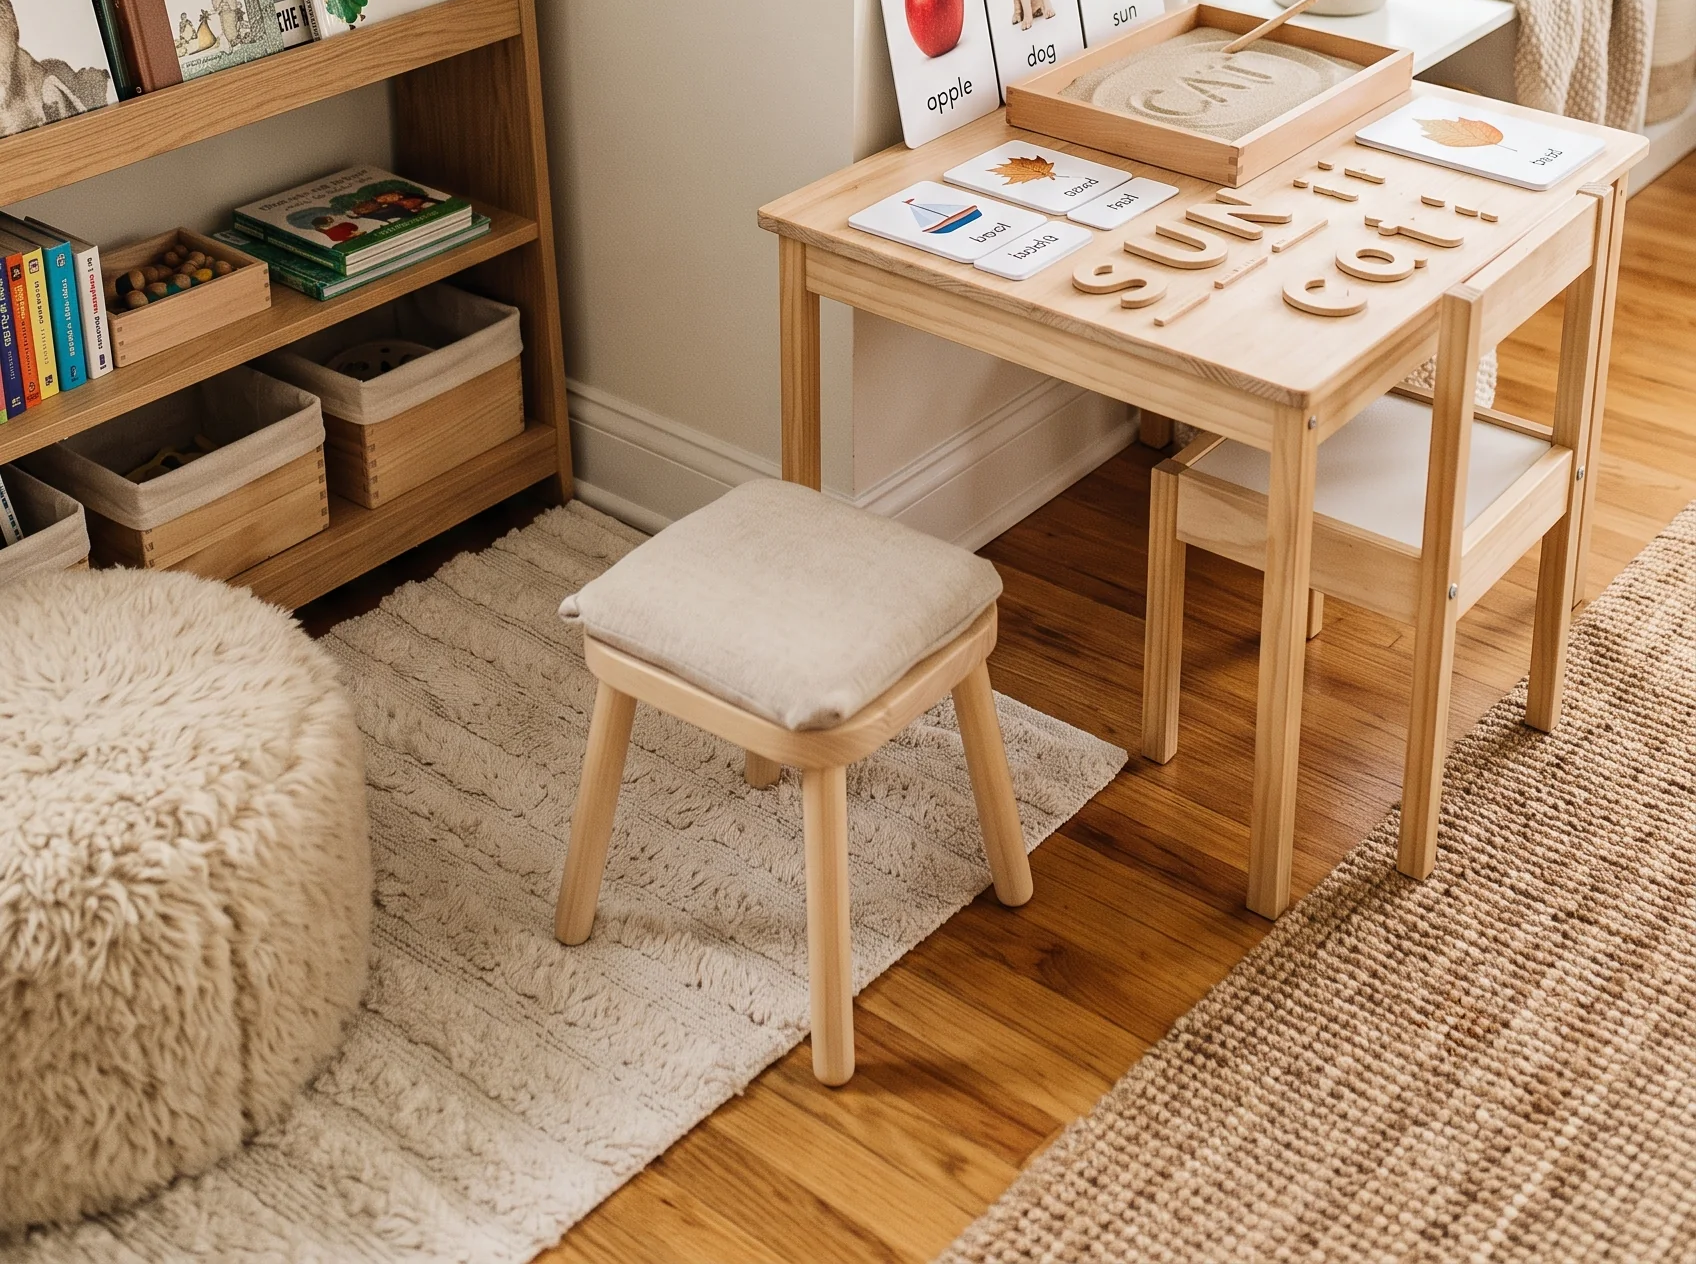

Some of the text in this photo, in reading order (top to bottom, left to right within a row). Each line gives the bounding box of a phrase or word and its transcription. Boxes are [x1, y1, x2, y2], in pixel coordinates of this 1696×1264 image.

[1112, 3, 1138, 28] sun
[1026, 41, 1057, 68] dog
[926, 77, 973, 115] apple
[1072, 187, 1293, 309] SUN
